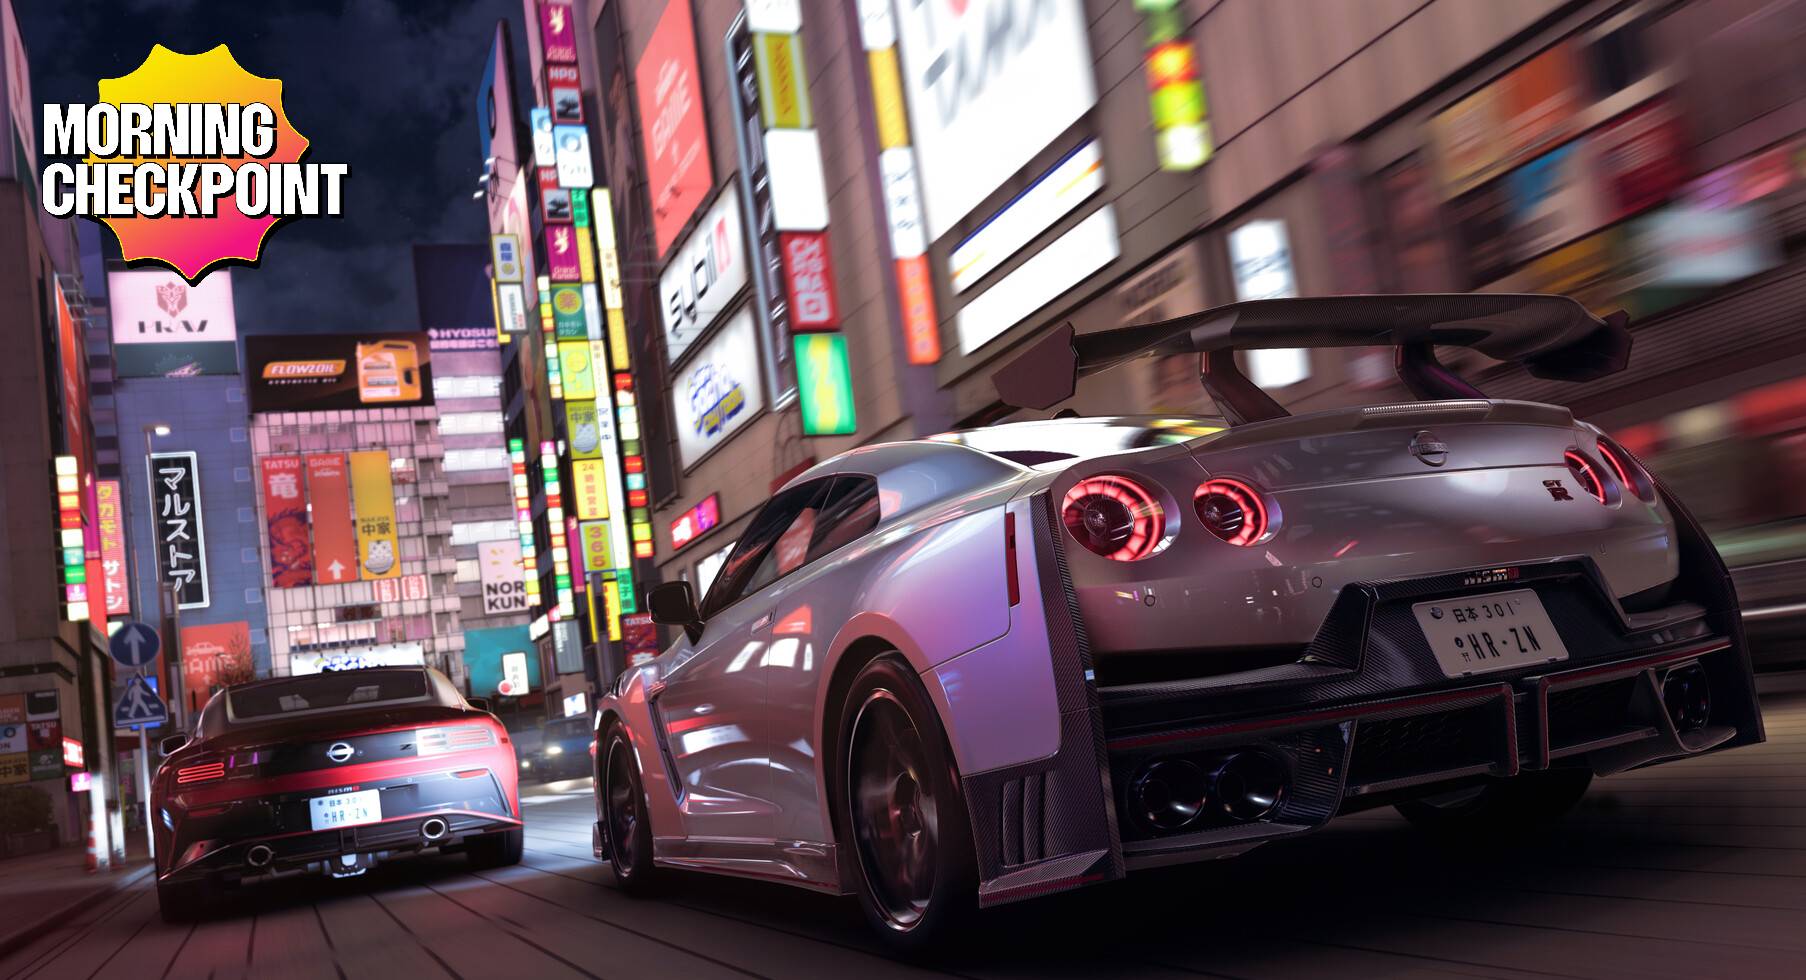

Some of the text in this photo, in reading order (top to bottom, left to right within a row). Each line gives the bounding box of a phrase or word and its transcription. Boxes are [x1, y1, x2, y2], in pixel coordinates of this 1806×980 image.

[159, 467, 196, 592] マルストア
[102, 559, 123, 611] サトシ
[486, 580, 525, 596] NOR
[488, 595, 526, 611] KUN
[1453, 602, 1515, 624] 日本 301
